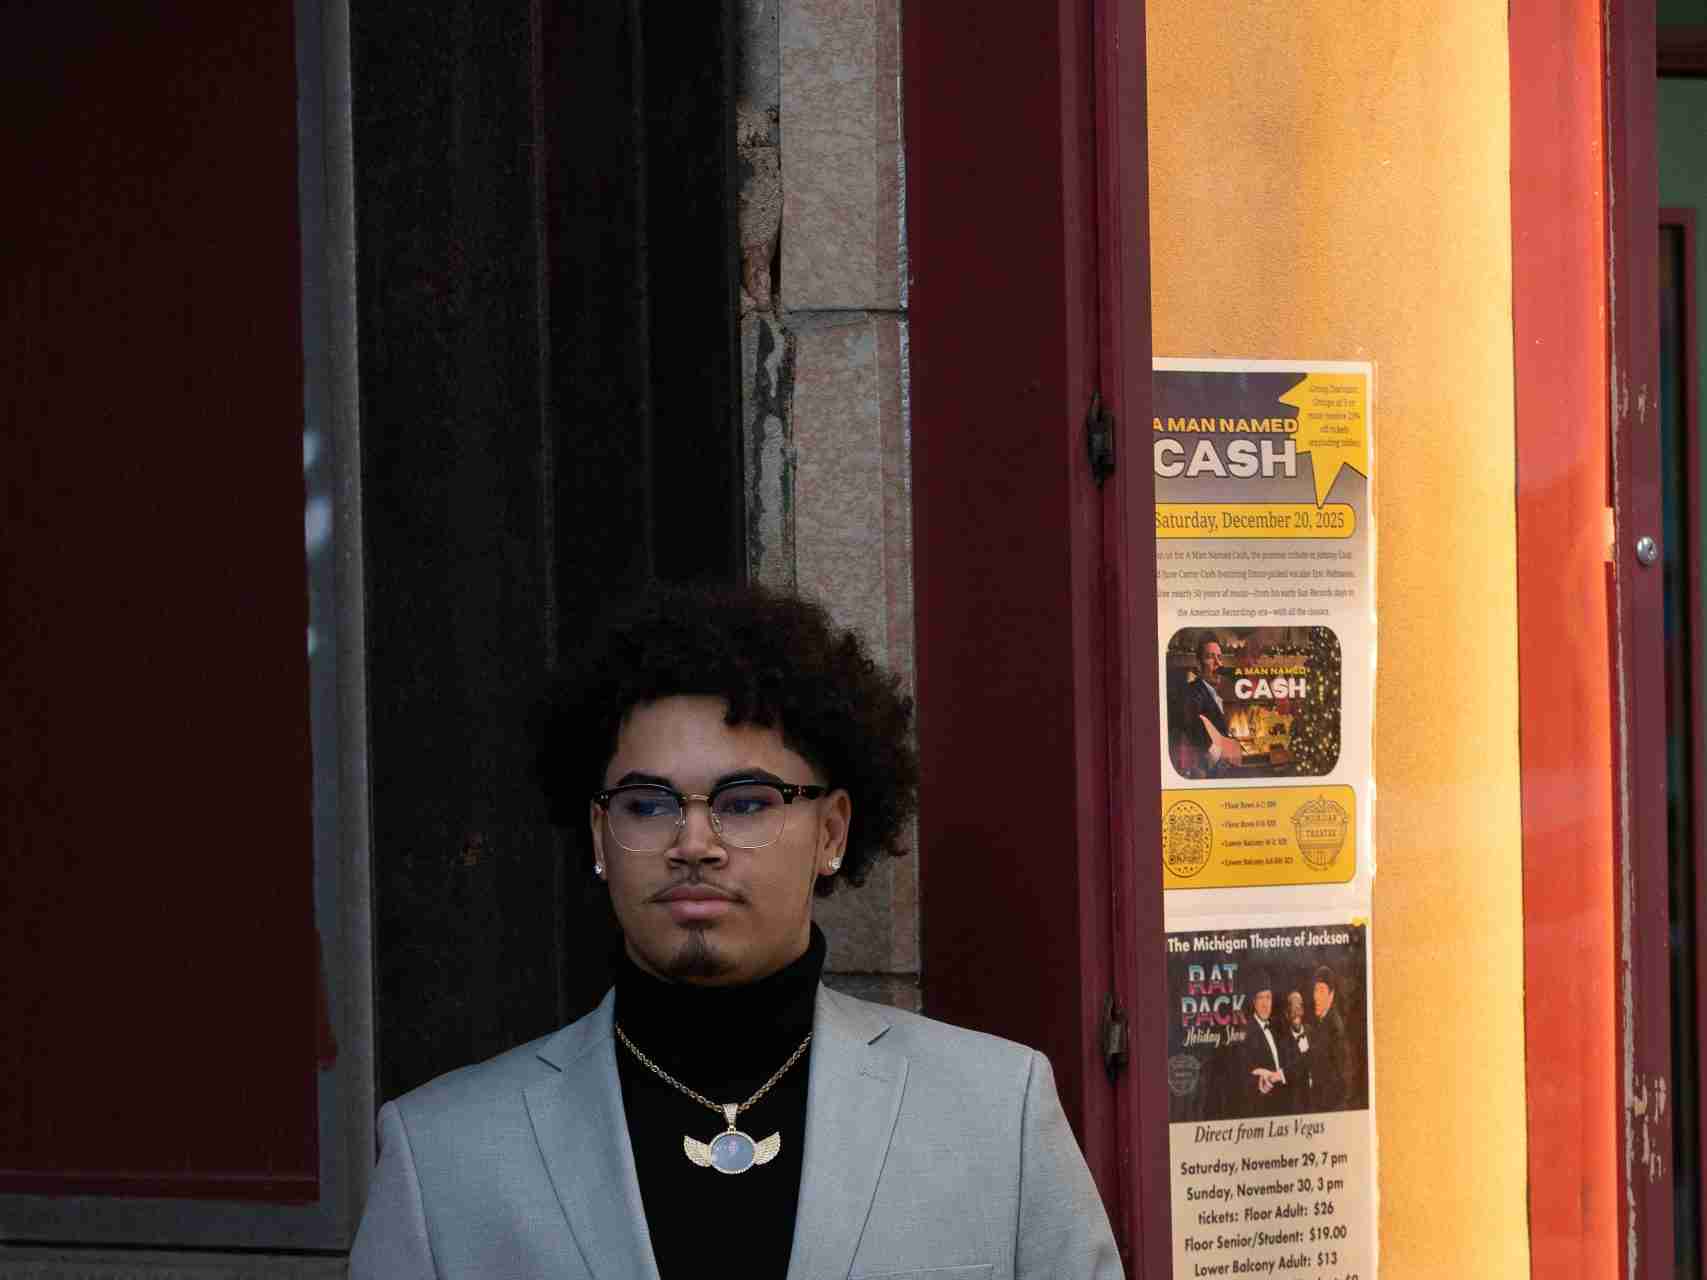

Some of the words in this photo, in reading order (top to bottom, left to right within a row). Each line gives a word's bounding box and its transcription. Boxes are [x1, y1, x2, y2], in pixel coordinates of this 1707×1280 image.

[1153, 417, 1164, 432] A
[1167, 417, 1216, 433] MAN
[1220, 418, 1300, 433] NAMED
[1153, 438, 1298, 479] CASH
[1155, 512, 1218, 534] Saturday,
[1222, 511, 1292, 529] December
[1315, 512, 1345, 529] 2025
[1234, 678, 1307, 700] CASH
[1168, 937, 1190, 953] The
[1193, 934, 1248, 954] Michigan
[1250, 932, 1292, 949] Theatre
[1294, 930, 1306, 947] of
[1307, 930, 1350, 948] Jackson
[1181, 993, 1248, 1028] PACK
[1193, 1125, 1234, 1144] Direct
[1234, 1122, 1265, 1146] from
[1267, 1121, 1290, 1139] Las
[1293, 1118, 1327, 1138] Vegas
[1180, 1158, 1238, 1177] Saturday,
[1241, 1153, 1300, 1171] November
[1301, 1152, 1319, 1168] 29,
[1321, 1151, 1329, 1166] 7
[1330, 1152, 1348, 1169] pm
[1186, 1184, 1234, 1203] Sunday,
[1236, 1178, 1296, 1198] November
[1297, 1177, 1314, 1194] 30,
[1317, 1176, 1325, 1192] 3
[1326, 1179, 1344, 1195] pm
[1198, 1208, 1239, 1225] tickets:
[1243, 1205, 1273, 1221] Floor
[1274, 1202, 1309, 1220] Adult:
[1313, 1200, 1335, 1218] $26
[1184, 1236, 1215, 1253] Floor
[1216, 1230, 1304, 1250] Senior/Student:
[1308, 1224, 1348, 1243] $19.00
[1194, 1261, 1230, 1278] Lower
[1232, 1256, 1276, 1277] Balcony
[1277, 1254, 1312, 1271] Adult:
[1316, 1251, 1338, 1268] $13
